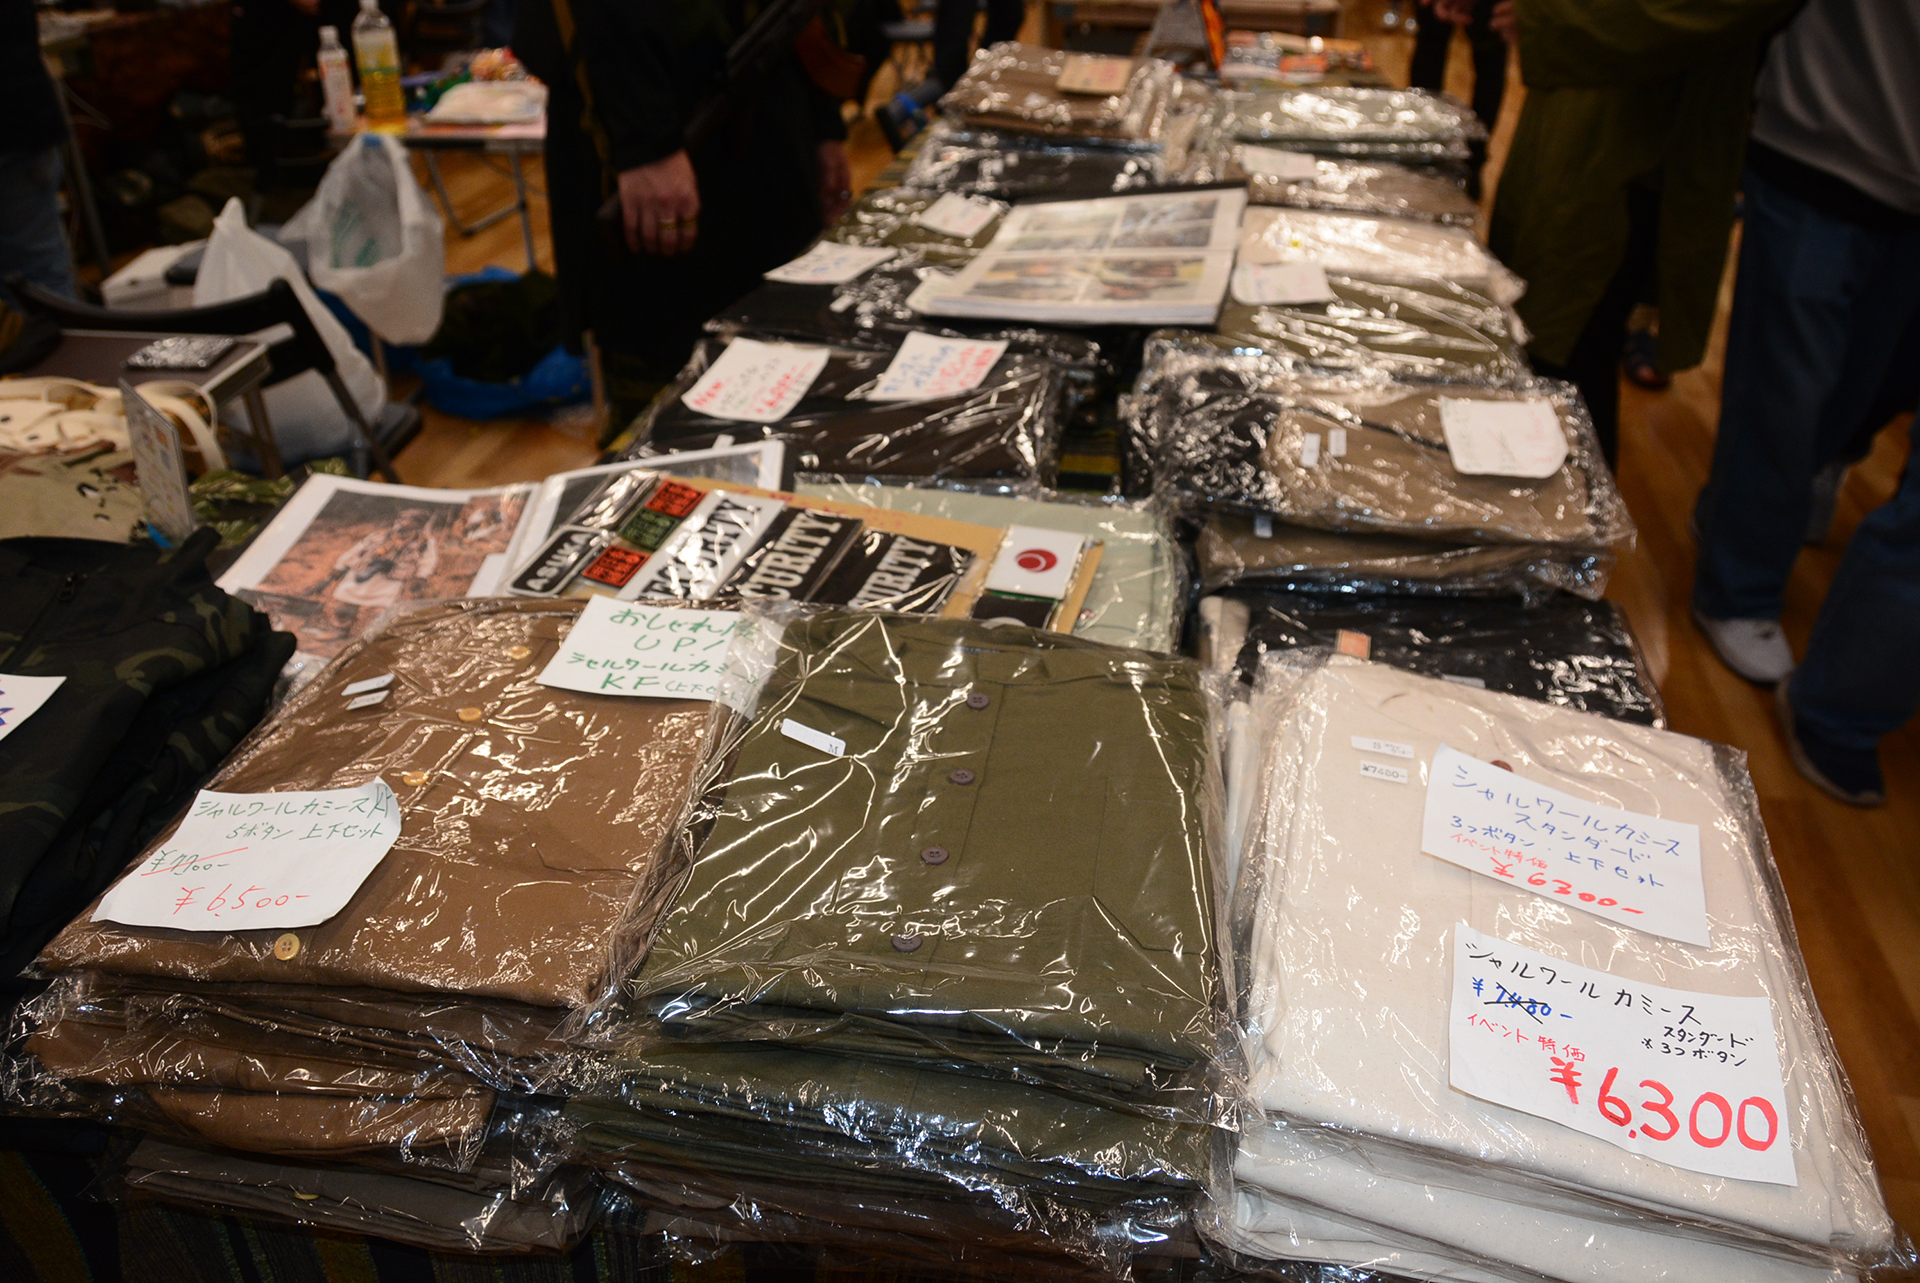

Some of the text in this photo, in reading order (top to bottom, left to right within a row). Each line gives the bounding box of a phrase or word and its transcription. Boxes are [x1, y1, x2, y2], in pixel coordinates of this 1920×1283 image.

[526, 532, 592, 591] ASUKA
[635, 498, 762, 600] ECURITY
[740, 511, 843, 601] CURITY
[827, 743, 839, 755] M
[1515, 812, 1650, 863] スタンダード
[1663, 1026, 1755, 1050] スタンダード
